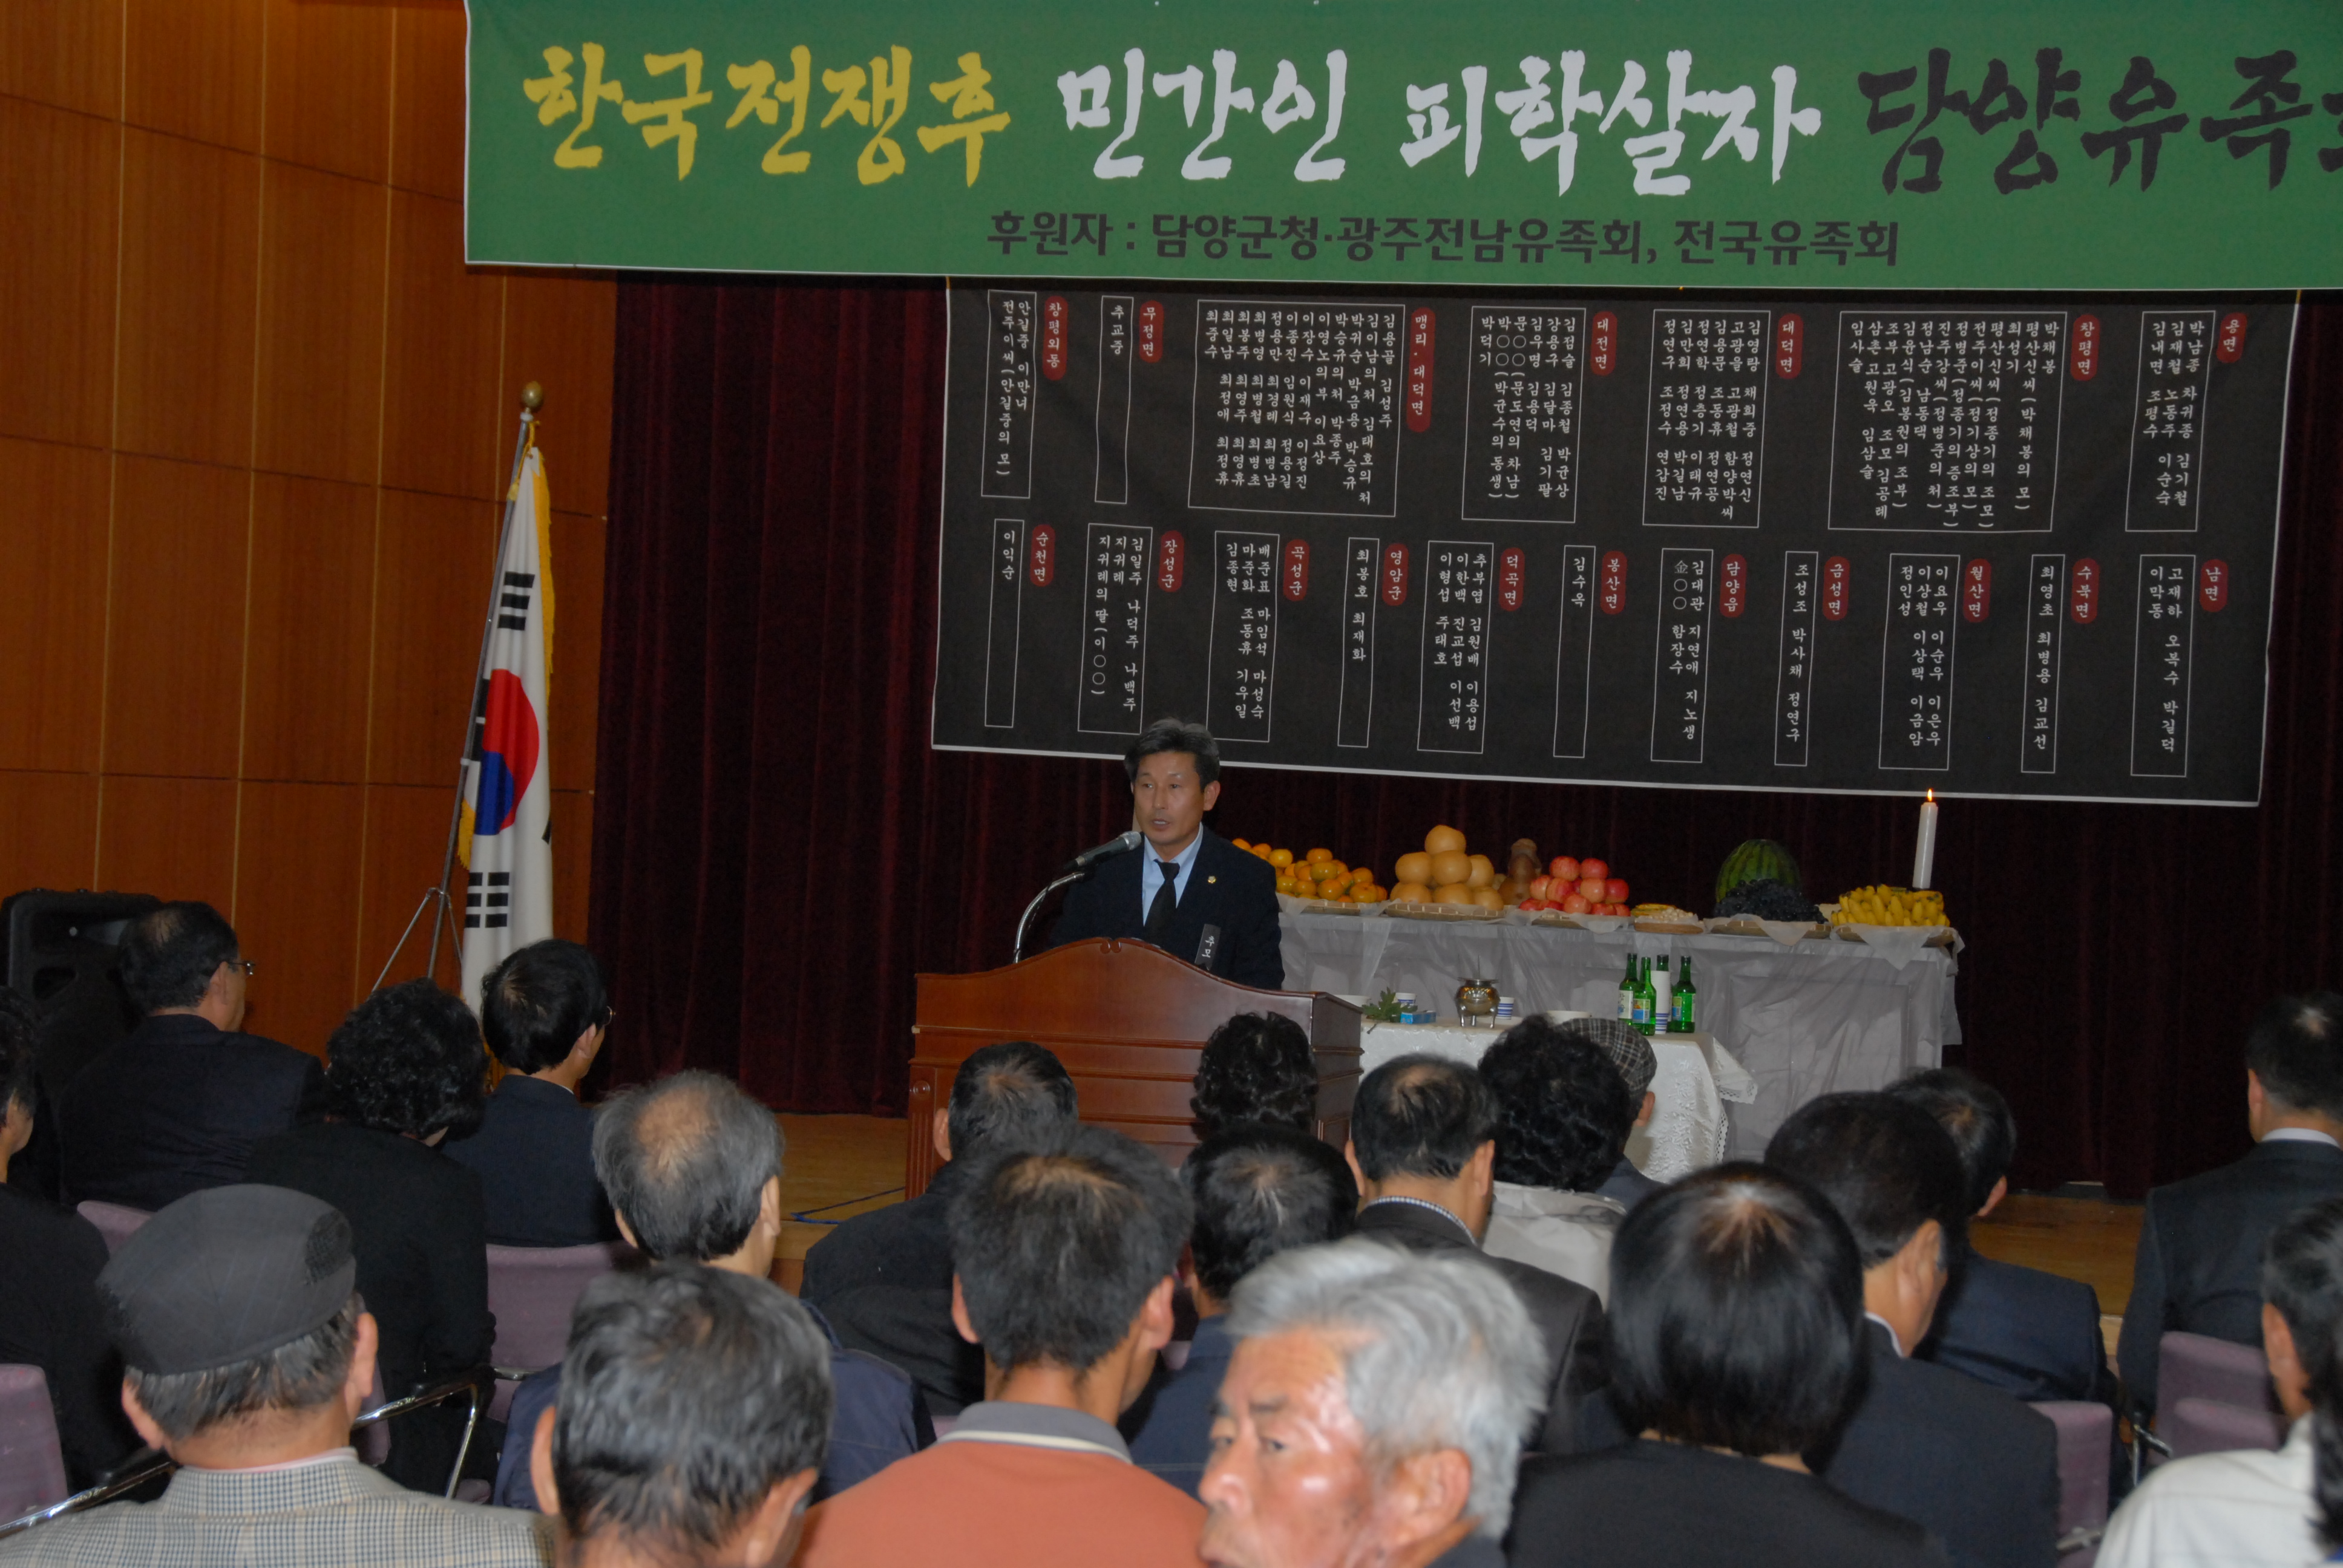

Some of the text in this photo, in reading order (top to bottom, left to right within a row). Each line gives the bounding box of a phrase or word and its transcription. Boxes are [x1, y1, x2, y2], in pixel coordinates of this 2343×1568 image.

[523, 42, 2343, 196] 한국전쟁후 민간인 피학살자 담양유족
[987, 210, 1114, 256] 후원자
[1674, 220, 1898, 267] 전국유족회
[1015, 301, 1031, 410] 안길중 이만녀
[1046, 302, 1062, 368] 창평외동
[1110, 305, 1124, 355] 추교중
[1142, 307, 1156, 356] 무정면
[1204, 309, 1219, 359] 최중수
[1269, 311, 1283, 362] 정용만
[1480, 315, 1495, 366] 박덕기
[1595, 318, 1608, 370] 대전면
[1696, 319, 1710, 371] 정연학
[1780, 321, 1794, 373] 대덕면
[1848, 321, 1865, 373] 임사술
[2007, 321, 2022, 374] 최성기
[2042, 321, 2059, 374] 박채봉
[2077, 321, 2095, 374] 창평면
[2223, 319, 2240, 352] 용면
[1378, 313, 1396, 428] 김용골 김성주
[1525, 316, 1544, 432] 김우명 김용덕
[2143, 321, 2166, 439] 김내면 조평수
[1215, 310, 1234, 486] 최일남 최정애 최정휴
[1231, 310, 1251, 486] 최봉주 최영주 최영휴
[1247, 310, 1266, 486] 최병영 최병철 최병초
[1280, 311, 1299, 489] 이종진 임원식 정용길
[1296, 312, 1316, 489] 이장수 이재구 이정진
[1343, 313, 1365, 490] 박귀순 박금용 박승규
[1538, 316, 1561, 498] 강용구 김달마 김기팔
[1555, 317, 1576, 498] 김점술 김종철 박균상
[1655, 319, 1676, 501] 정연구 조정수 연갑진
[1671, 319, 1694, 501] 김만희 정연용 박길남
[1705, 319, 1727, 502] 김용문 조동휴 정연공
[1725, 387, 1742, 437] 고광철
[1738, 319, 1760, 503] 김영랑 채희중 정연신
[2155, 321, 2184, 505] 김재철 노동주 이순숙
[2174, 320, 2205, 506] 박남종 차귀종 김기철
[1263, 437, 1277, 488] 최병남
[1312, 415, 1326, 465] 이요상
[1328, 416, 1345, 465] 박종주
[1859, 427, 1876, 480] 임삼술
[1688, 450, 1702, 501] 이태규
[1001, 530, 1015, 580] 이익순
[1034, 532, 1049, 581] 순천면
[1113, 536, 1127, 585] 지귀례
[1161, 539, 1178, 588] 장성군
[1226, 542, 1239, 592] 김종현
[1289, 546, 1305, 595] 곡성군
[1388, 550, 1403, 600] 영암군
[1504, 555, 1519, 605] 덕곡면
[1352, 549, 1369, 661] 최봉호 최재화
[1434, 552, 1452, 665] 이형섭 주태호
[1571, 557, 1586, 607] 김수옥
[1605, 558, 1620, 609] 봉산면
[1724, 561, 1740, 612] 담양읍
[1828, 563, 1844, 615] 금성면
[1898, 565, 1913, 616] 정인성
[1968, 566, 1984, 617] 월산면
[2076, 566, 2092, 618] 수북면
[2148, 566, 2164, 619] 이막동
[2204, 567, 2221, 601] 남면
[1122, 537, 1143, 711] 김일주 나덕주 나백주
[1235, 543, 1256, 719] 마준화 조동휴 기우일
[1251, 544, 1271, 719] 배준표 마임석 마성숙
[1448, 553, 1470, 730] 이한백 진교섭 이선백
[1467, 617, 1481, 667] 김원배
[1669, 624, 1686, 675] 함장수
[1683, 560, 1705, 740] 김대관 지연애 지노생
[1786, 564, 1809, 742] 조성조 박사채 정연구
[1909, 565, 1932, 746] 이상철 이상택 이금암
[1926, 566, 1948, 746] 이요우 이순우 이은우
[2034, 566, 2054, 750] 최영초 최병용 김교선
[2161, 568, 2183, 752] 고재하 오복수 박길덕
[1465, 681, 1480, 731] 이용섭
[1201, 935, 1215, 958] 추모
